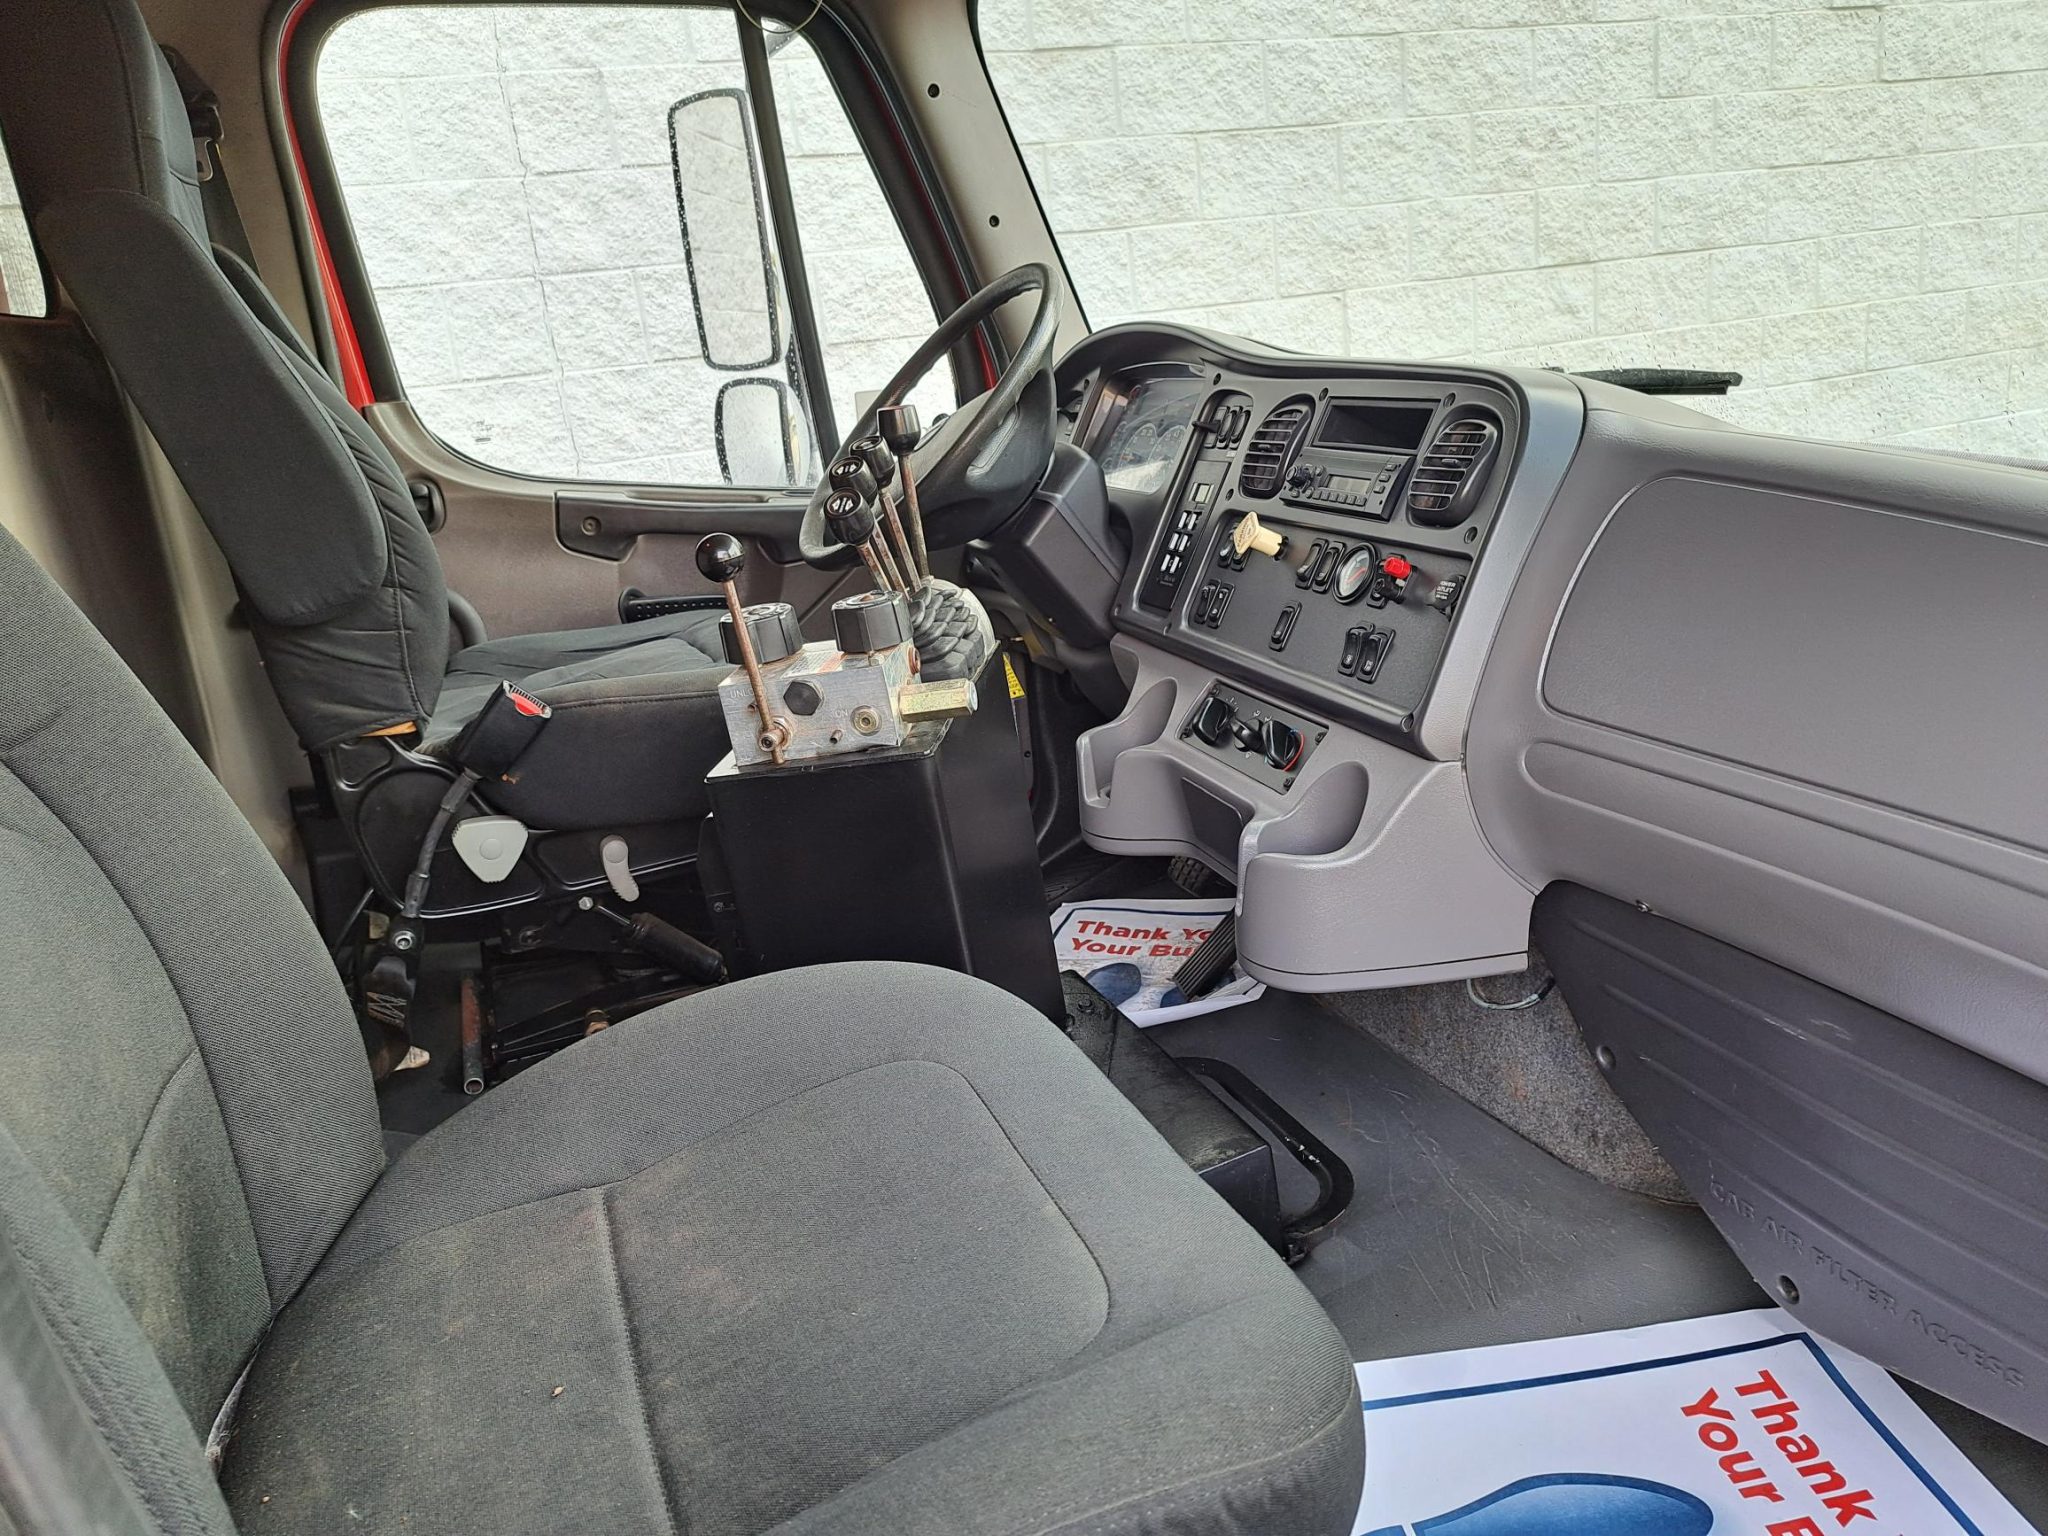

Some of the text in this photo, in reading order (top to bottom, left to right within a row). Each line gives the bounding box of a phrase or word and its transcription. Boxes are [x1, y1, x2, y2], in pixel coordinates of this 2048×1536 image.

[1071, 937, 1194, 957] Your Bu
[1077, 920, 1214, 944] Thank Yo
[1710, 1178, 2025, 1390] CAB AIR FILTER ACCESS
[1680, 1387, 1785, 1503] Your
[1734, 1369, 1878, 1528] Thank
